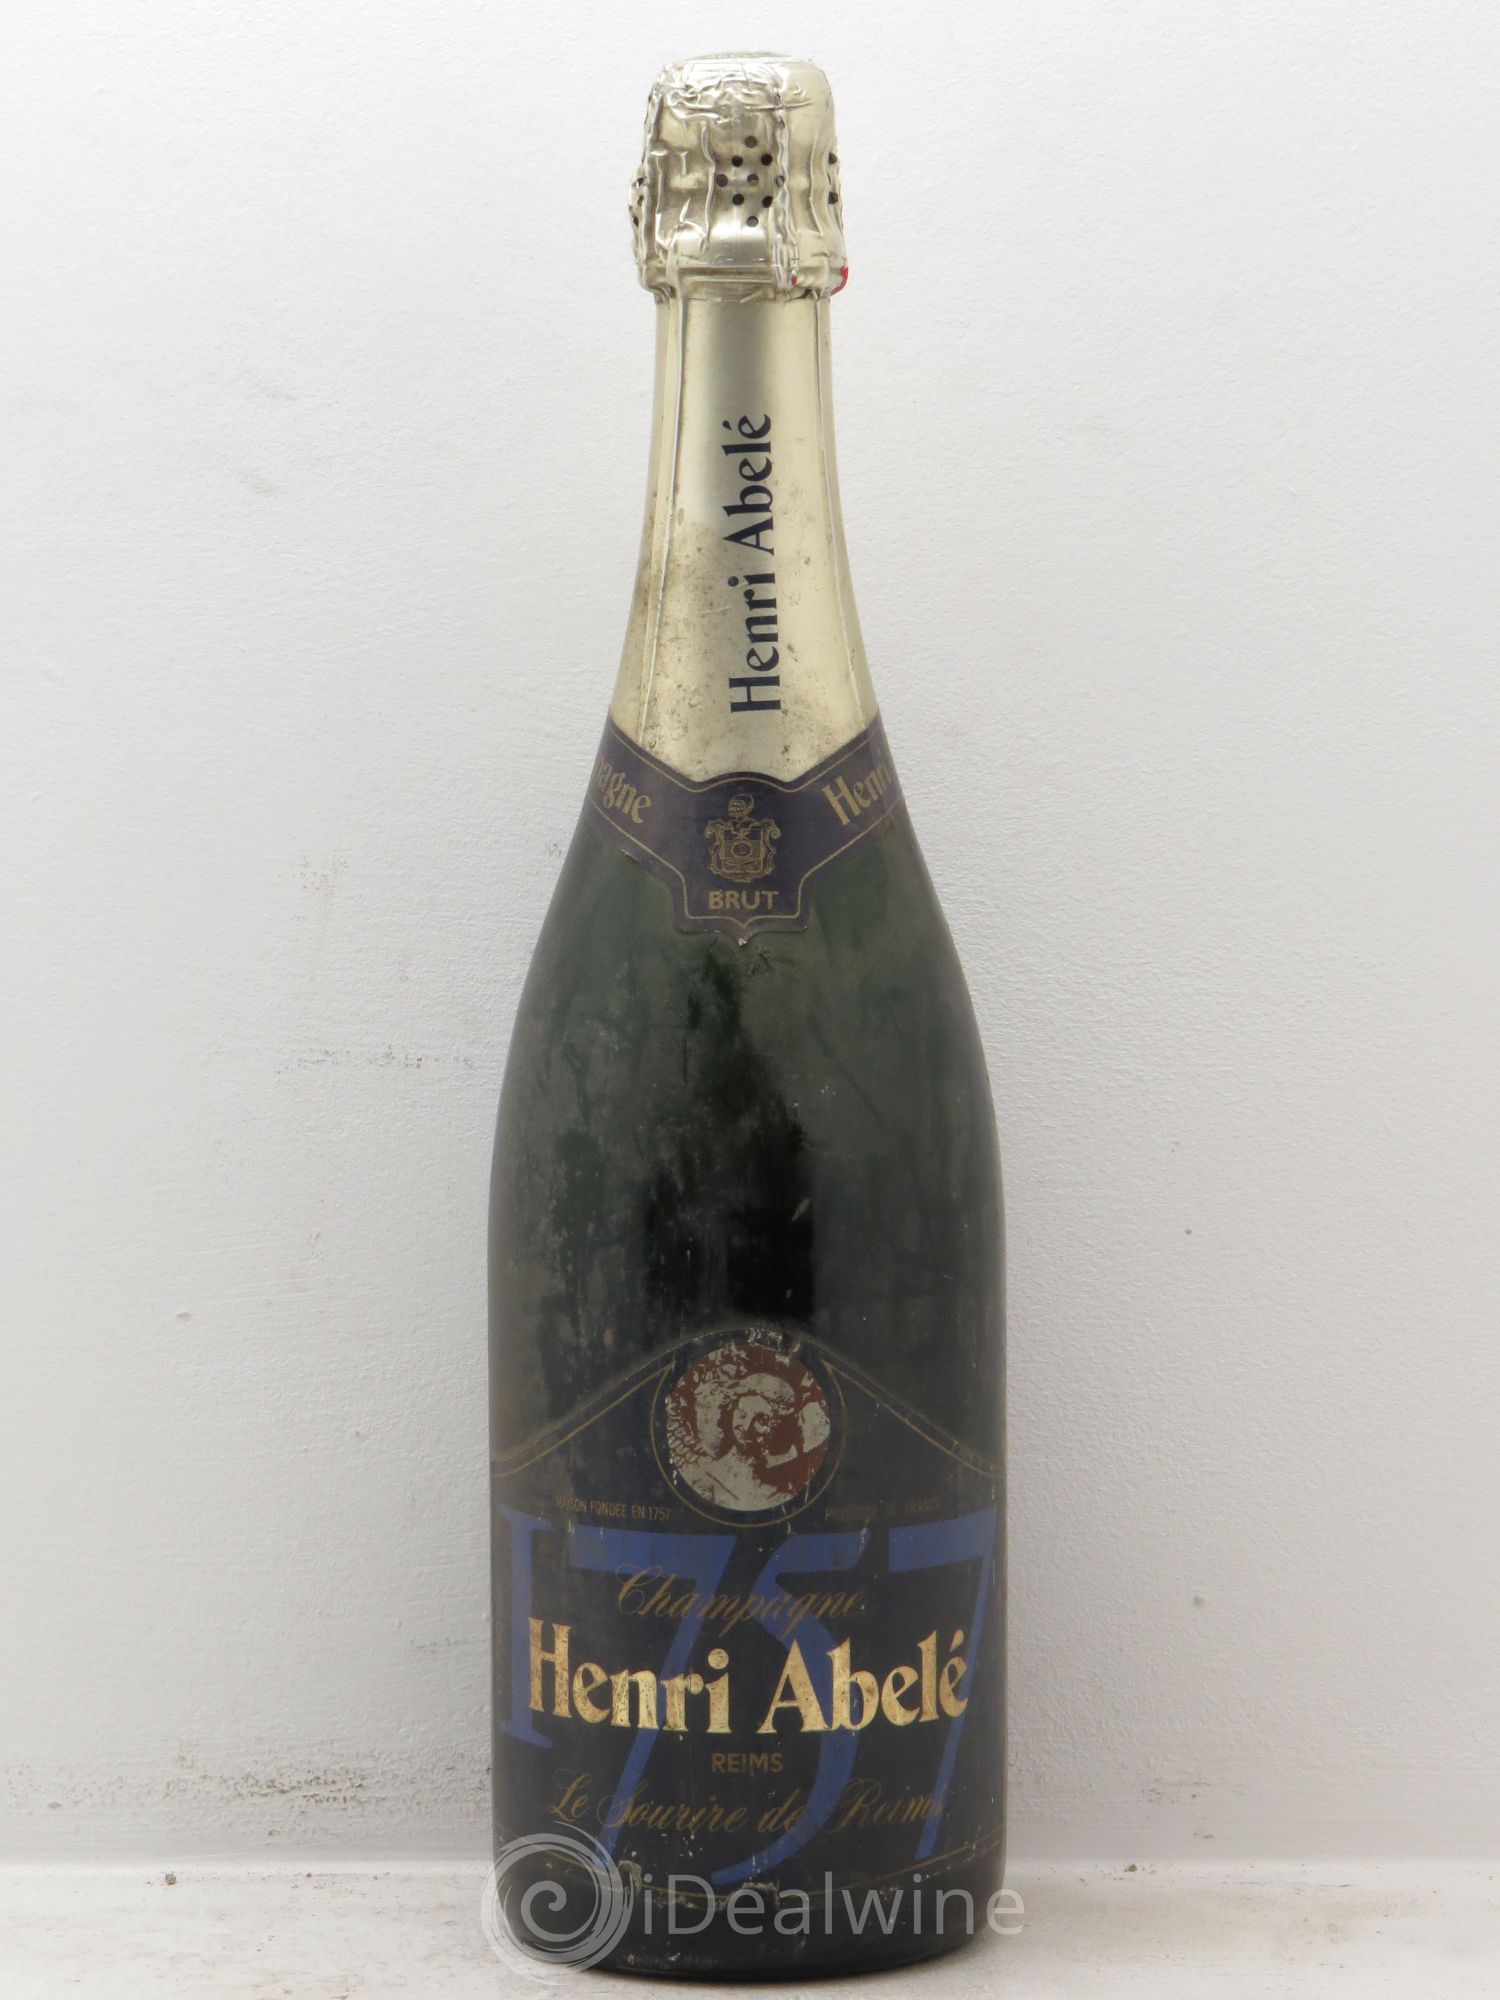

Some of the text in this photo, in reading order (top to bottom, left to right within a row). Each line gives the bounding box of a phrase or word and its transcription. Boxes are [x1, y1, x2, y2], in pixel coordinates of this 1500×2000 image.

[721, 414, 781, 714] Henri Abelé
[707, 889, 780, 911] BRUT
[631, 1504, 645, 1519] EN
[648, 1505, 673, 1521] 1757
[614, 1562, 865, 1639] Champagne
[527, 1616, 969, 1734] Henri Abelé
[711, 1751, 784, 1773] REIMS
[547, 1767, 592, 1822] Le
[756, 1788, 805, 1834] de
